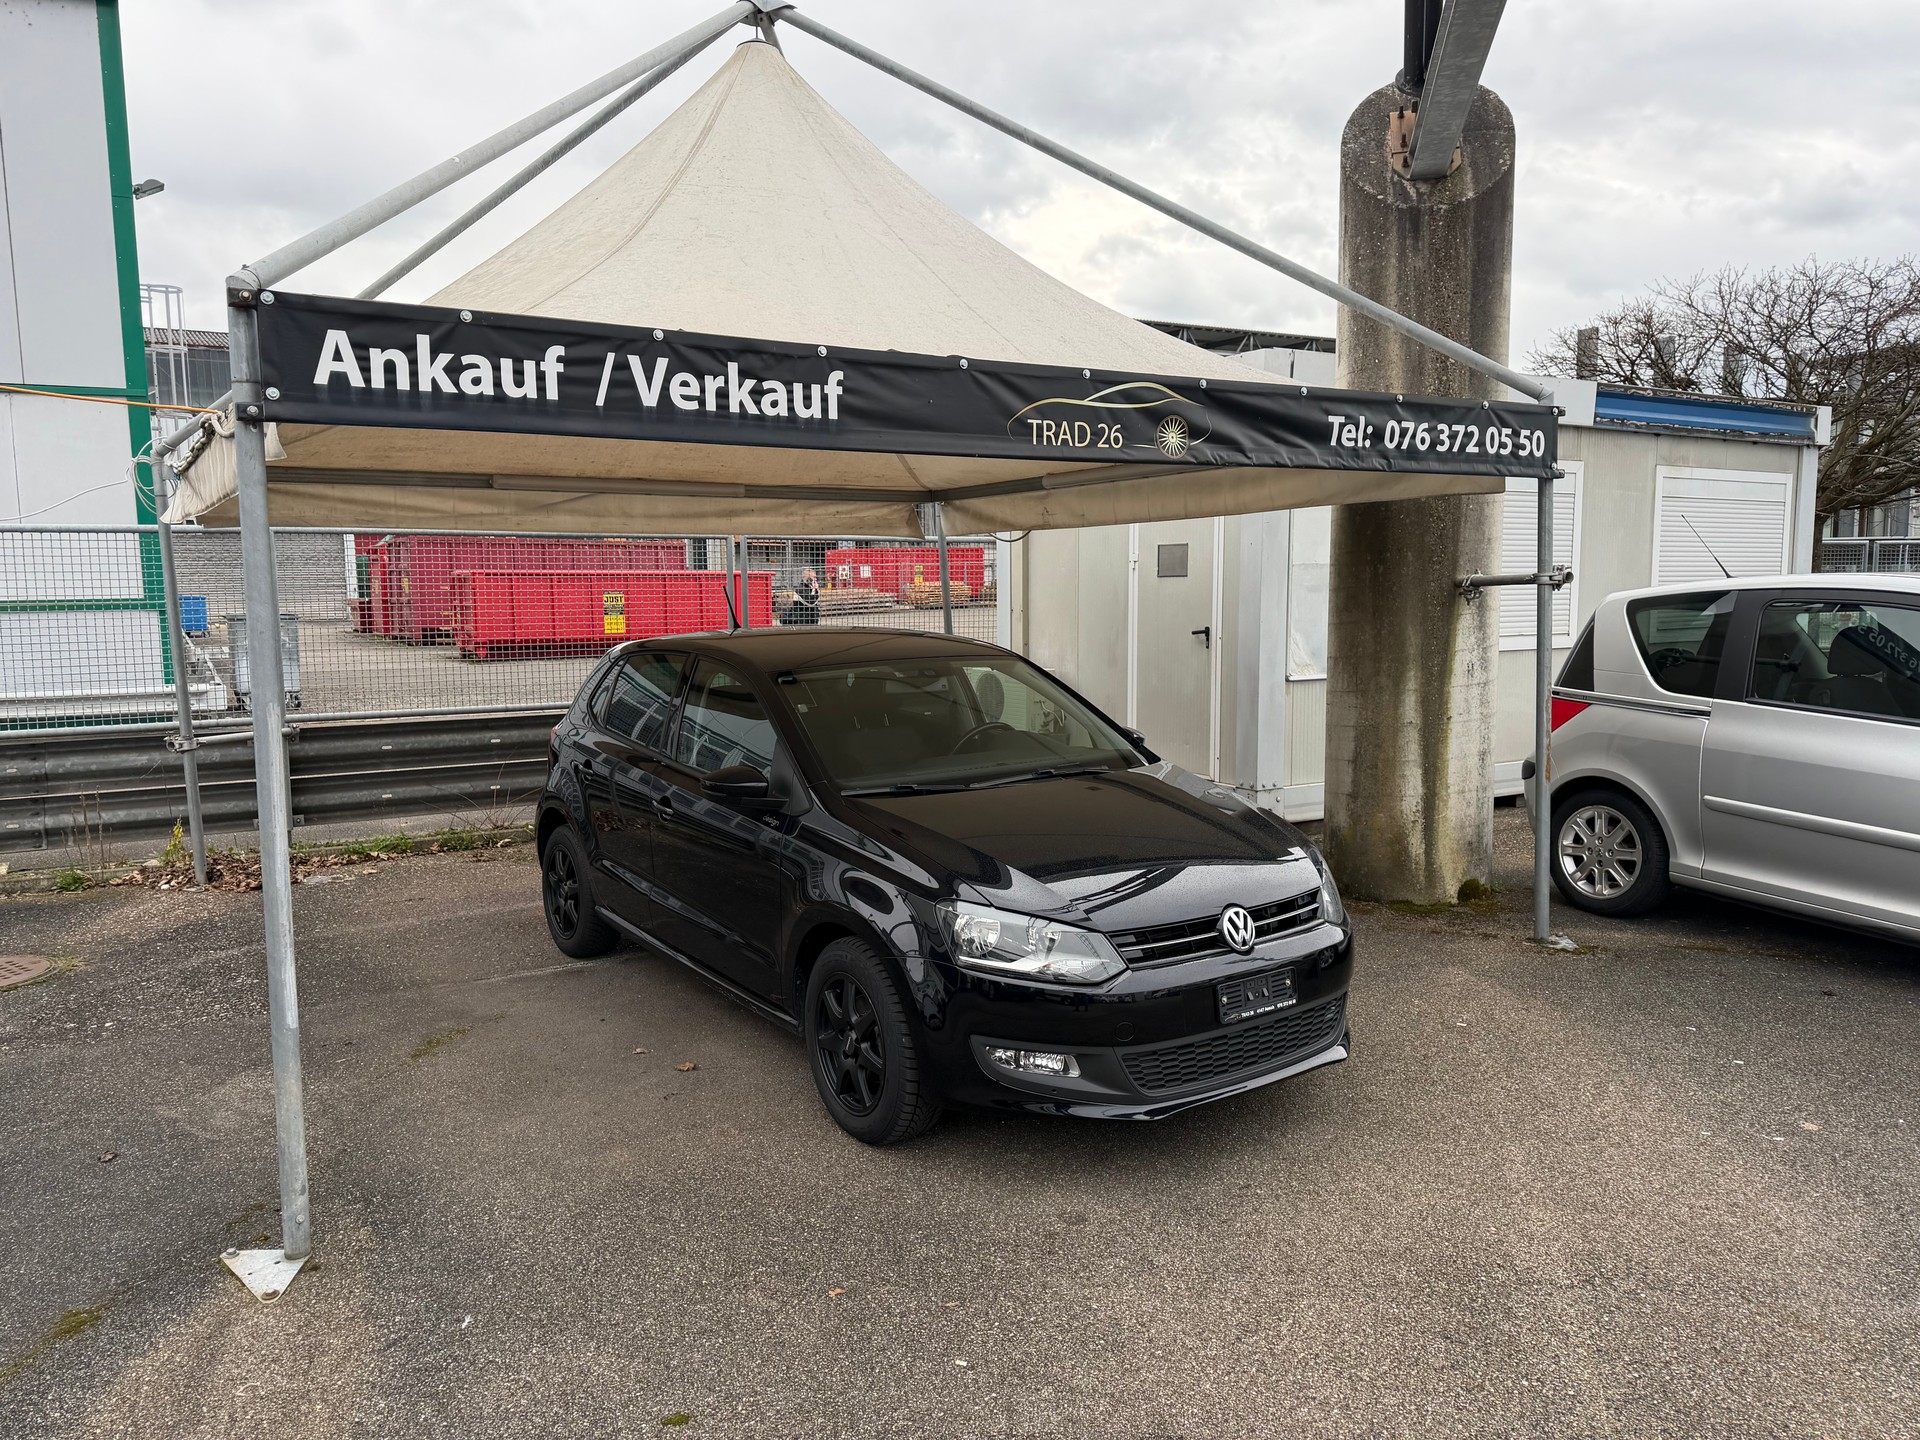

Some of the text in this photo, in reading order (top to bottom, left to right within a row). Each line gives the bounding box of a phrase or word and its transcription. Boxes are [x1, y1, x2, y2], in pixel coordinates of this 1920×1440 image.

[313, 329, 565, 400] Ankauf
[1027, 419, 1123, 449] TRAD 26
[1328, 415, 1545, 457] Tel: 076 372 05 50
[763, 814, 780, 827] design
